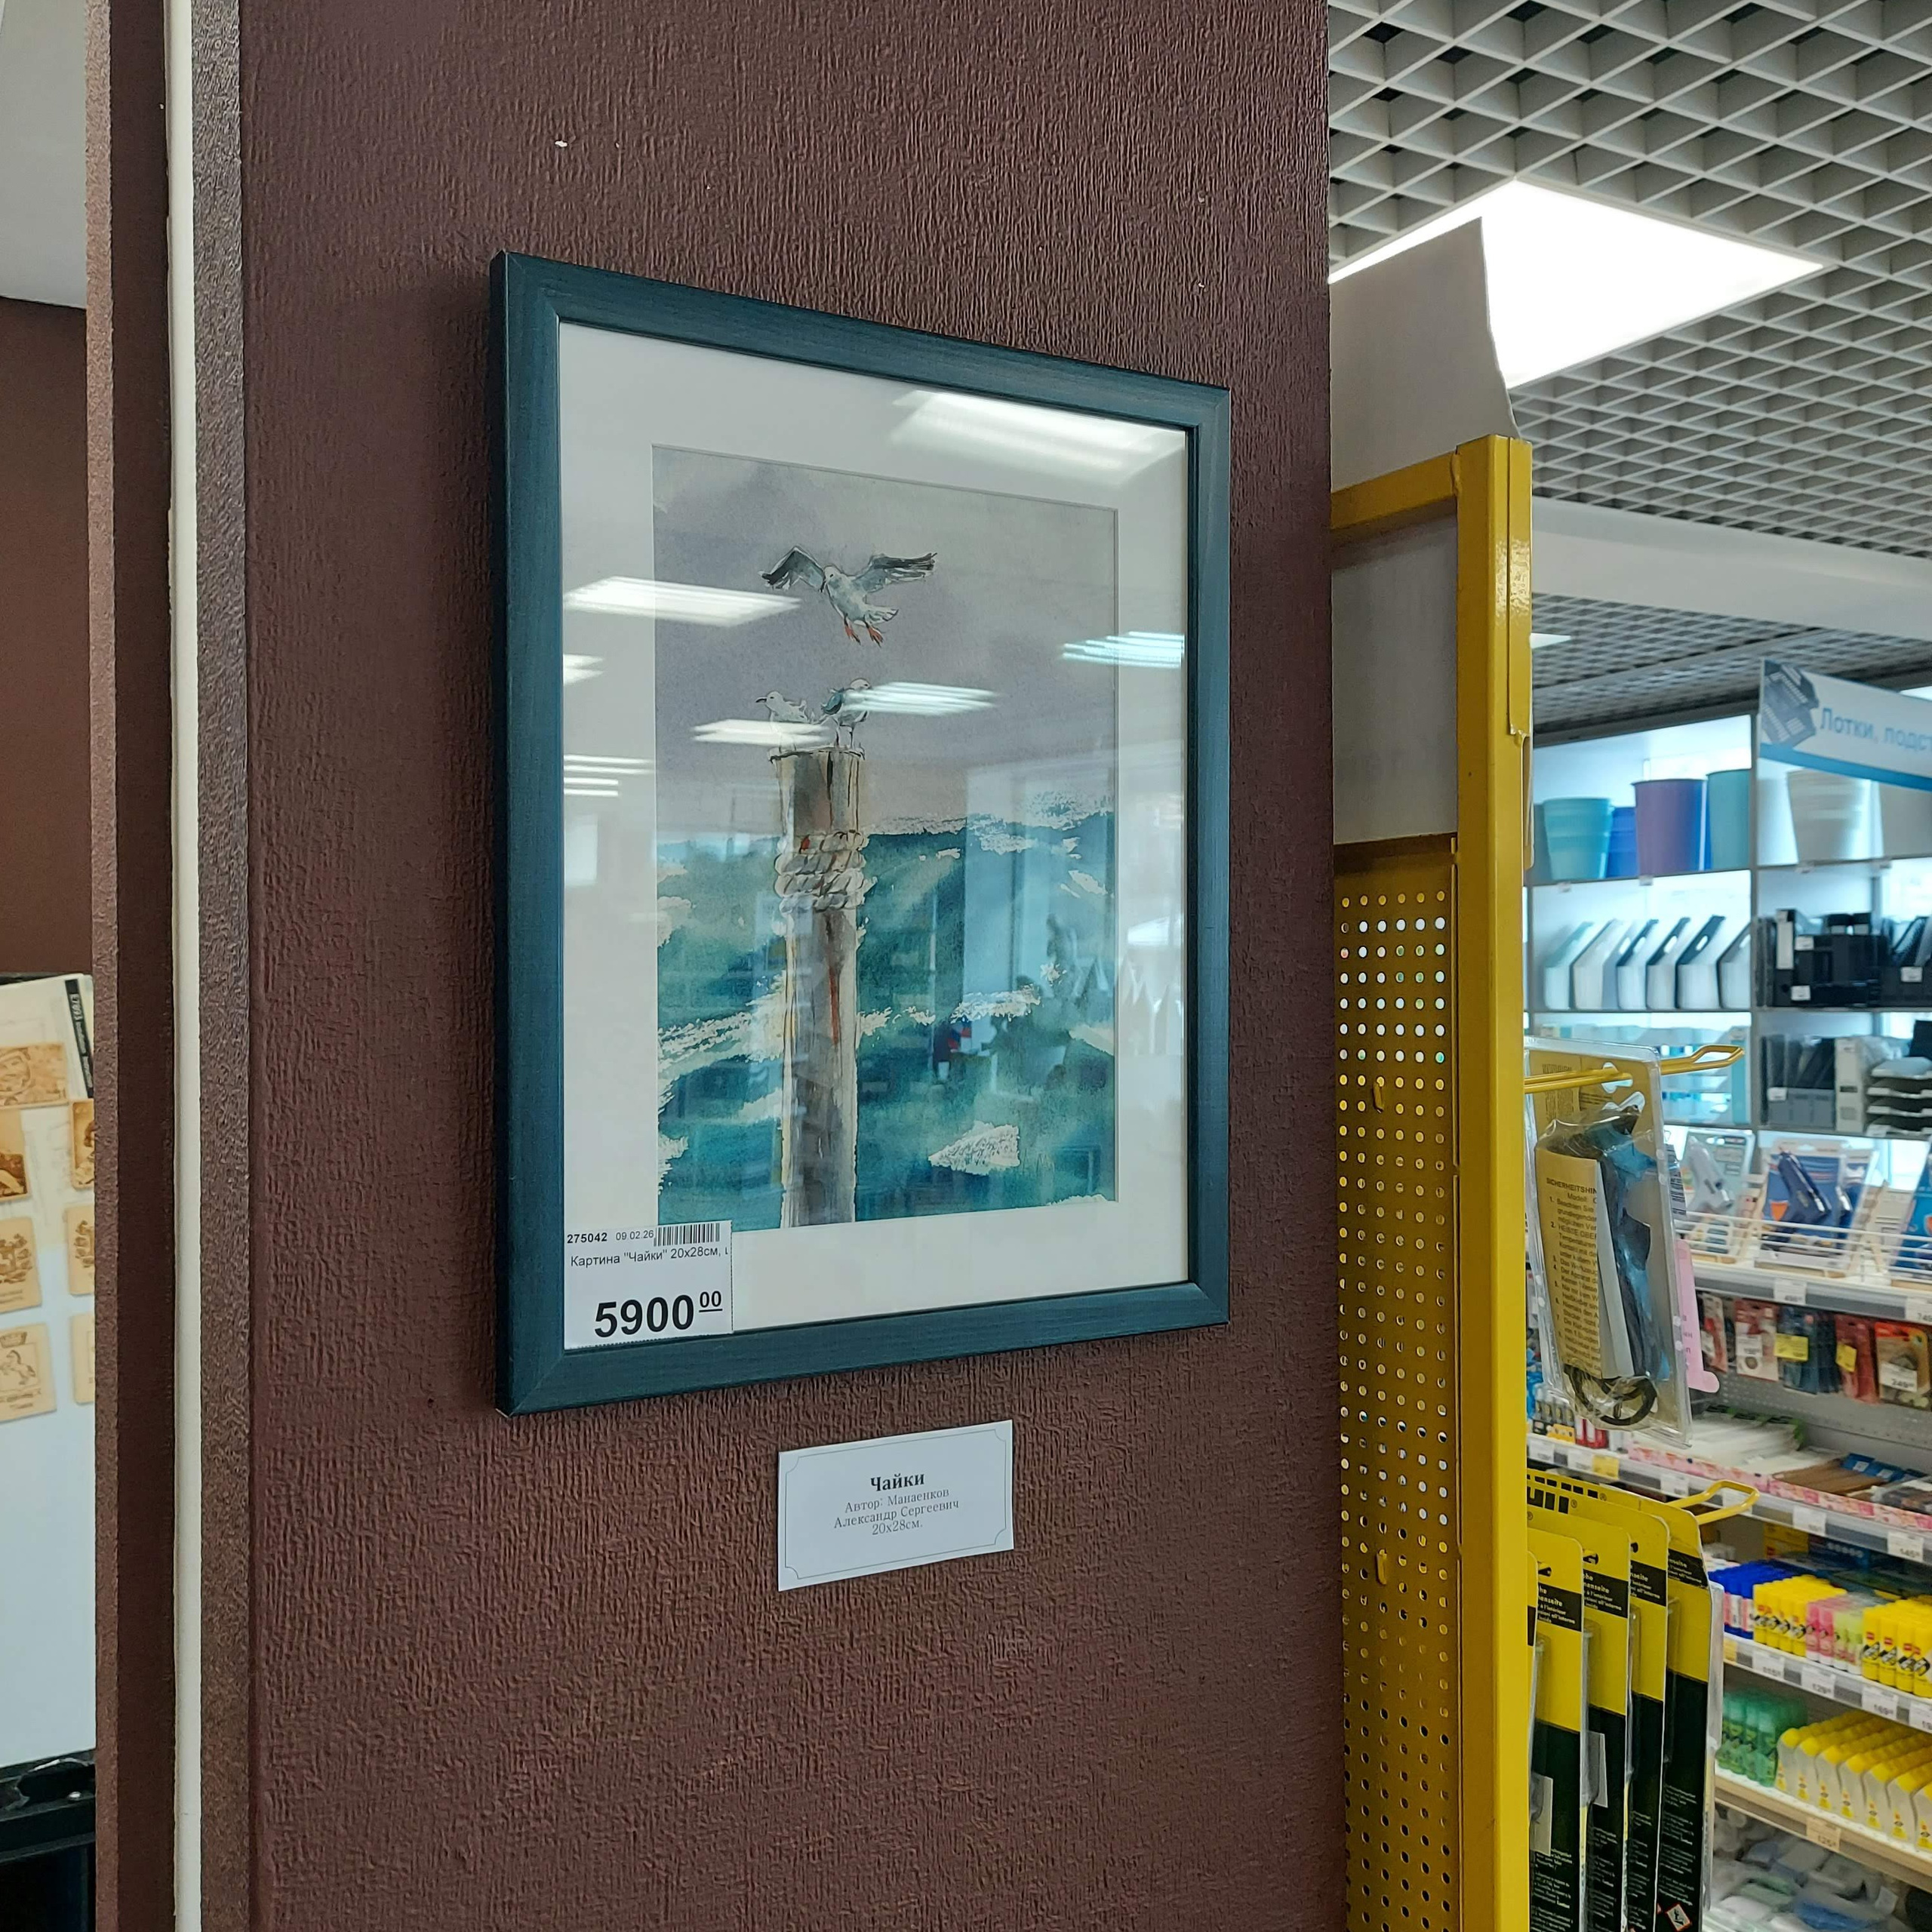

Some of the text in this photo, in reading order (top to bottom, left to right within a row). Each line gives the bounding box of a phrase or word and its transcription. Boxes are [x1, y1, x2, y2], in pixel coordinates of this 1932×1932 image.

[1820, 707, 1878, 743] Лотки,
[567, 1232, 608, 1244] 275042
[571, 1254, 620, 1268] Картина
[623, 1250, 668, 1263] "Чайки"
[595, 1294, 694, 1338] 5900
[870, 1473, 925, 1491] Чайки
[844, 1488, 949, 1513] Автор: Манаенков
[834, 1500, 959, 1528] Александр Сергеевич
